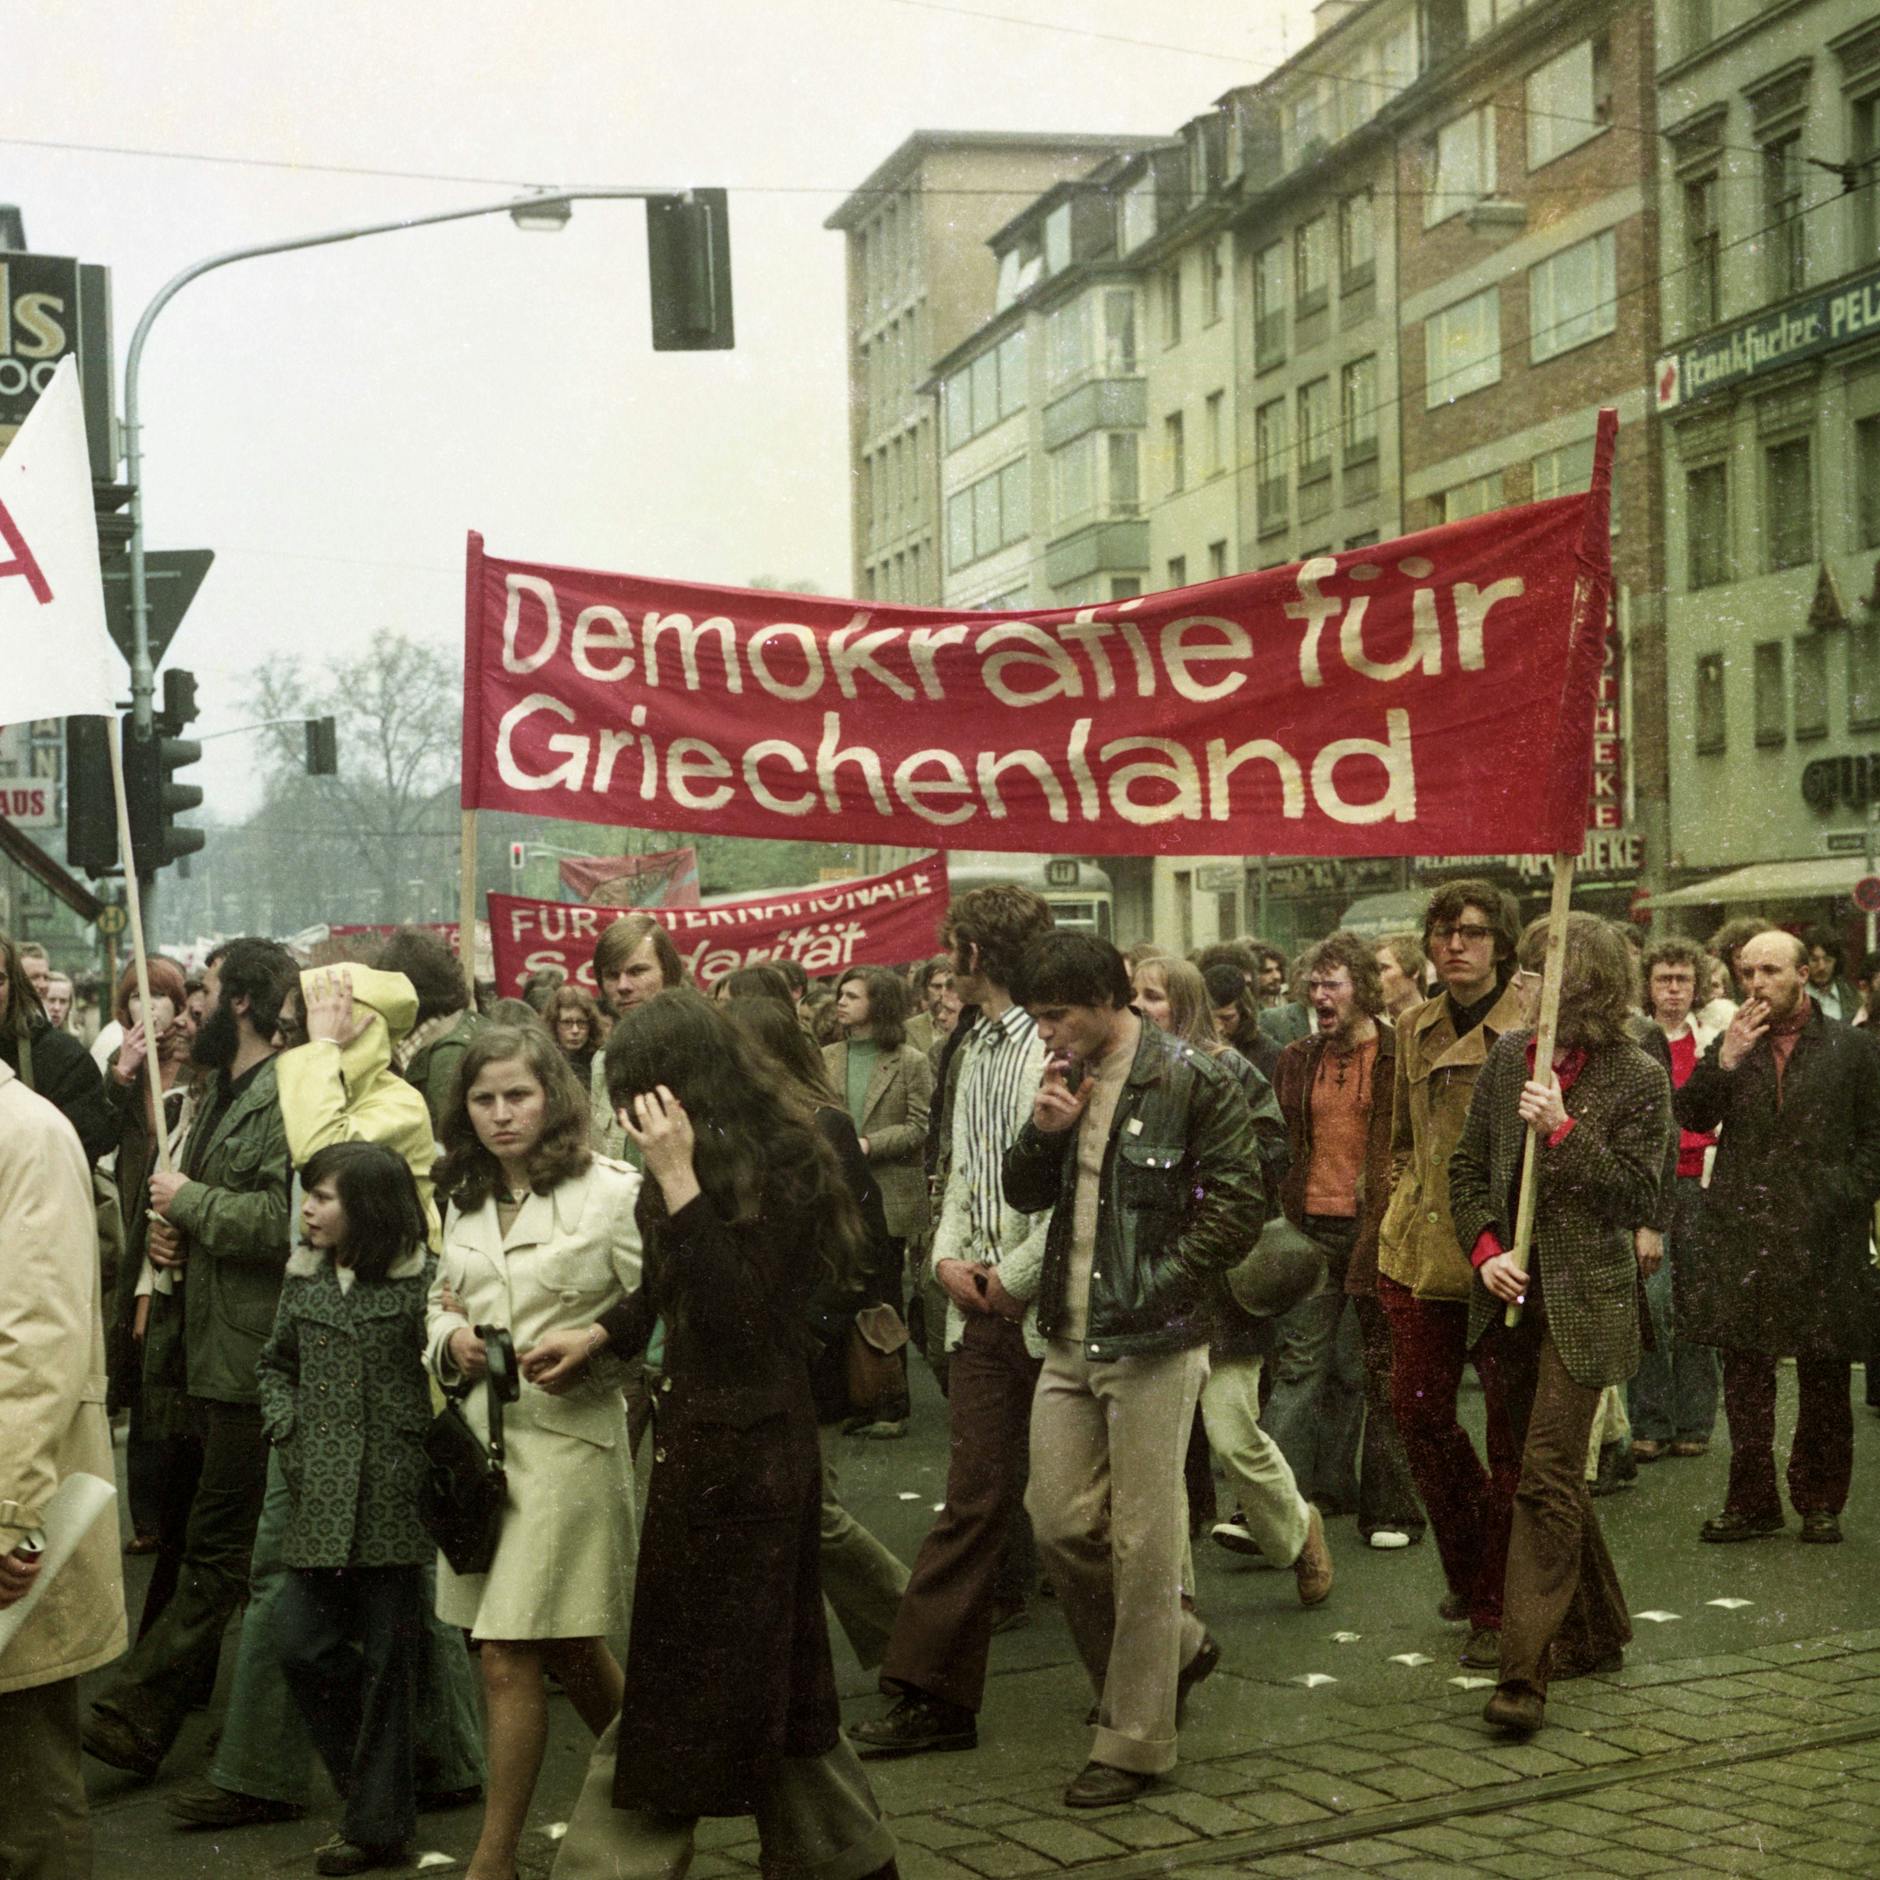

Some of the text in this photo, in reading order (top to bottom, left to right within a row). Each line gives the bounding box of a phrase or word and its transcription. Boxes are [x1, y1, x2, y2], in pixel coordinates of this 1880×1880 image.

[1831, 282, 1880, 338] PEL
[502, 557, 1524, 707] Demokratie für
[496, 693, 1417, 826] Griechenland
